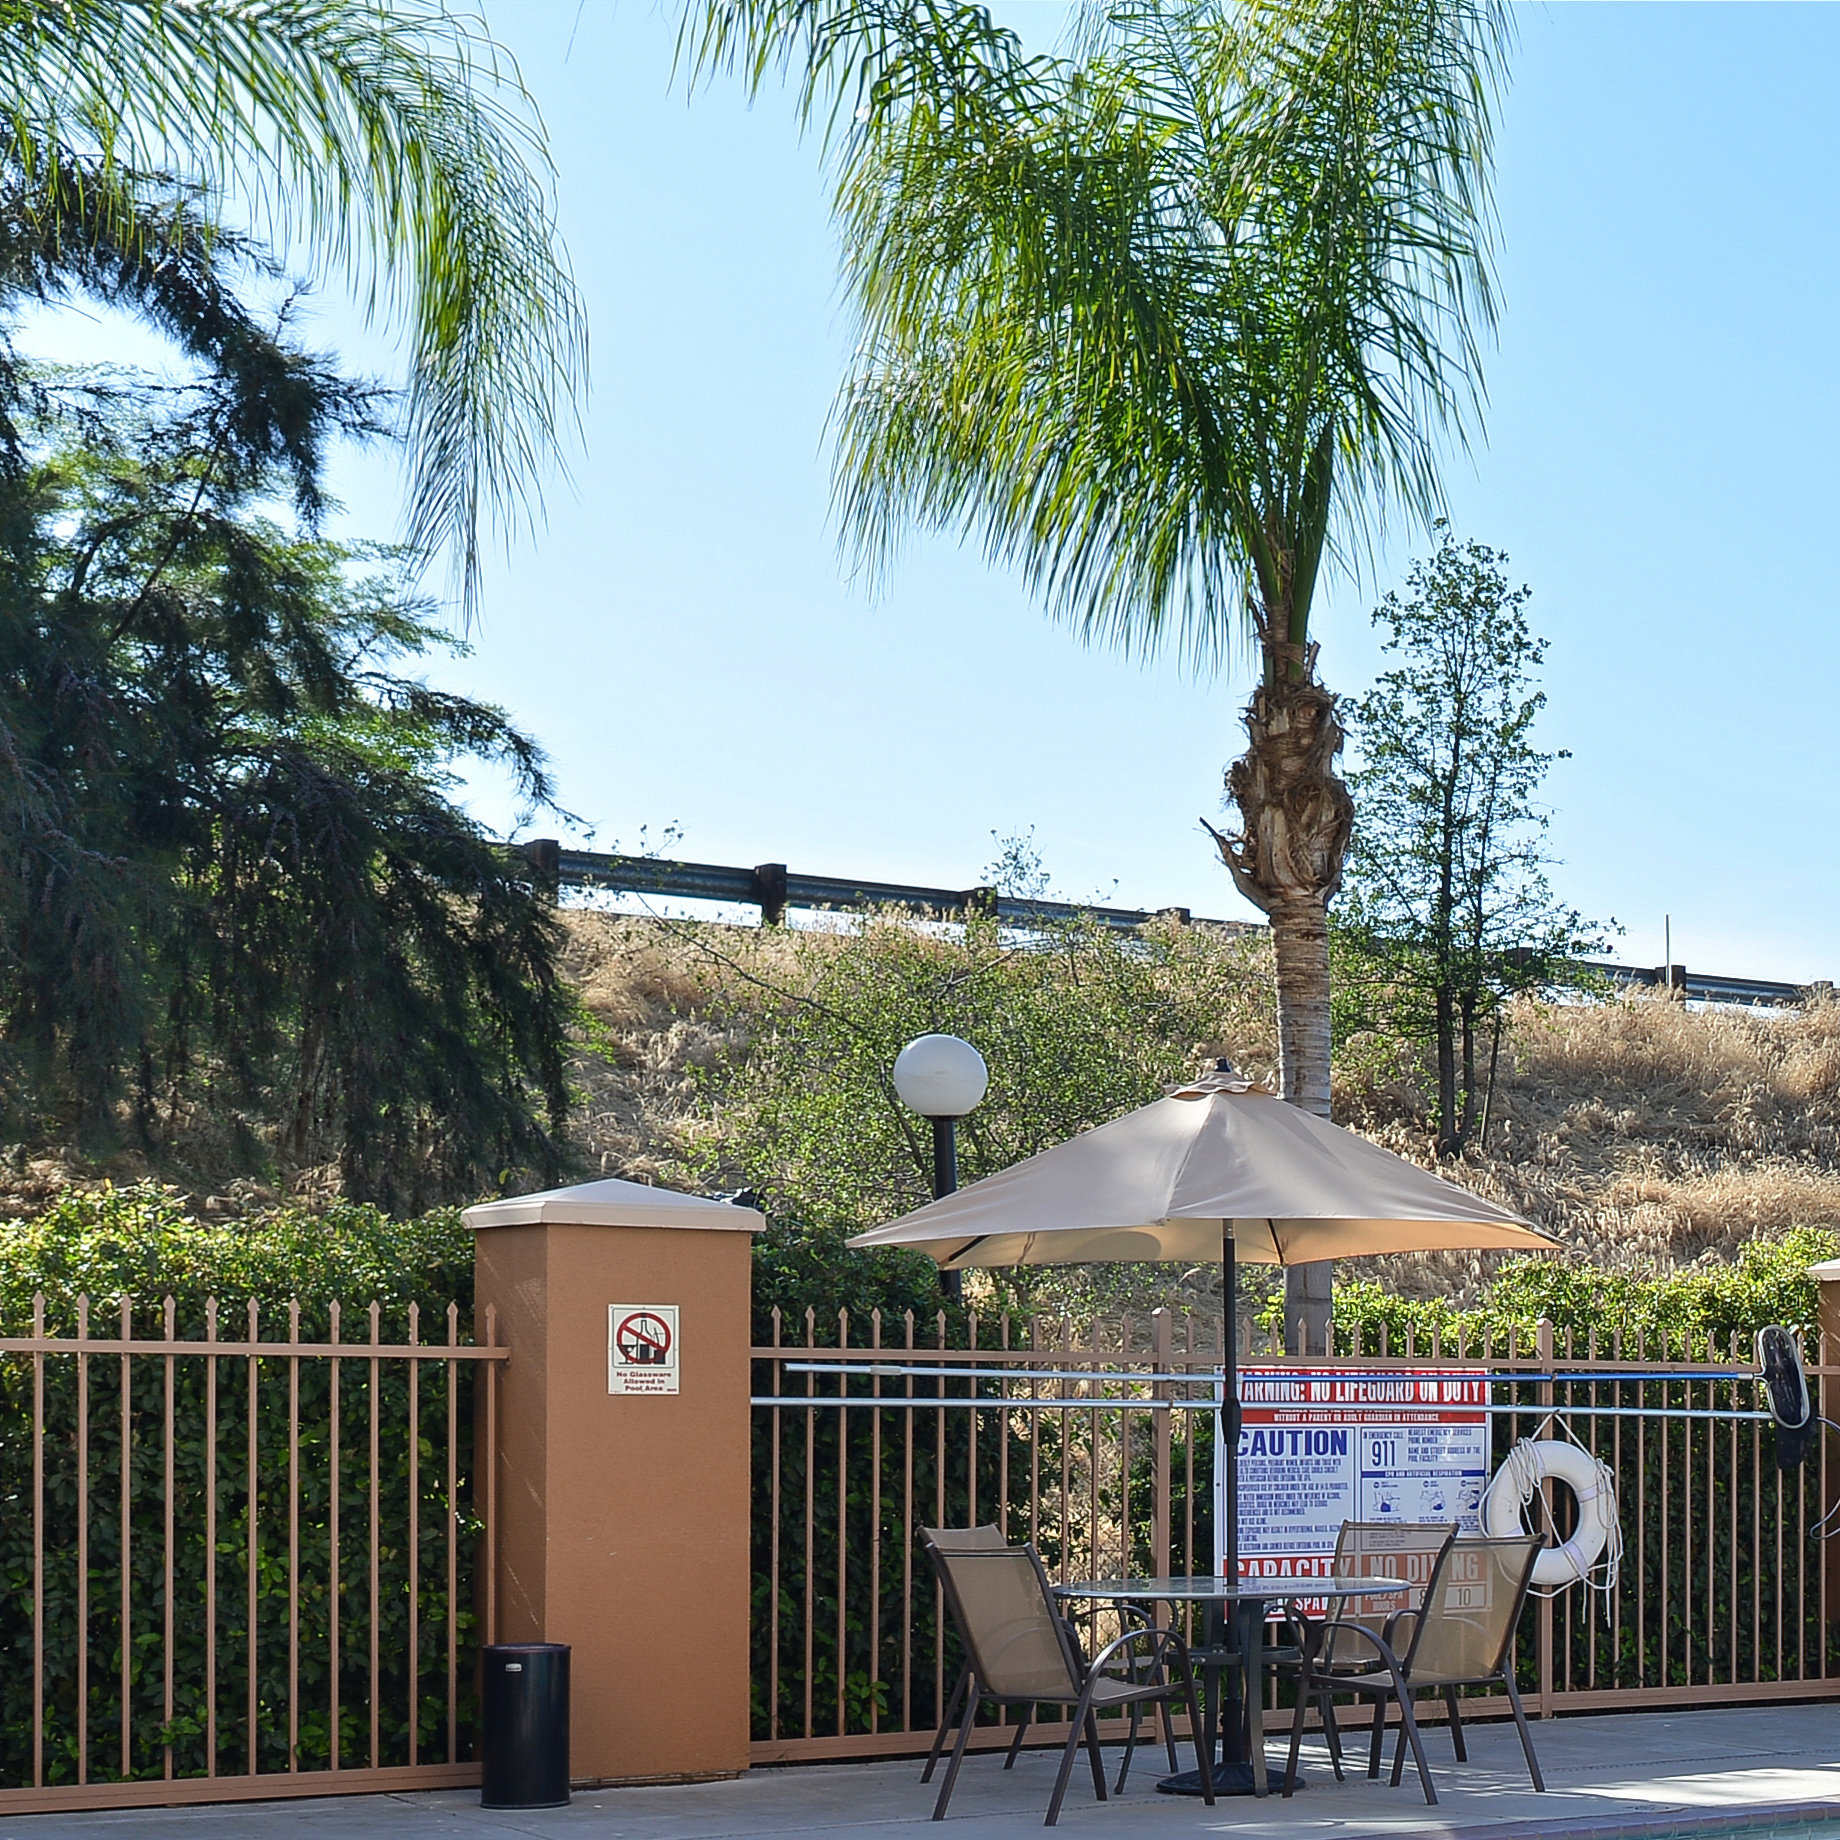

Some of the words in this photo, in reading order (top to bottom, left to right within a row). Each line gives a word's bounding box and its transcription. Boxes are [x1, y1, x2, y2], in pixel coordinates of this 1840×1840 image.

[1310, 1372, 1331, 1402] NO
[1335, 1372, 1414, 1402] LIFEGUARD
[1419, 1372, 1439, 1402] ON
[1442, 1373, 1480, 1403] DUTY
[1273, 1413, 1300, 1422] WITHOUT
[1302, 1414, 1307, 1422] A
[1308, 1413, 1332, 1422] PARENT
[1343, 1413, 1363, 1422] ADULT
[1402, 1413, 1440, 1422] ATTENDANCE
[1238, 1430, 1348, 1456] CAUTION
[1371, 1440, 1396, 1467] 911
[1238, 1557, 1351, 1578] APACITY
[1370, 1555, 1398, 1579] NO
[1407, 1552, 1479, 1583] DIVNG
[1457, 1588, 1472, 1606] 10
